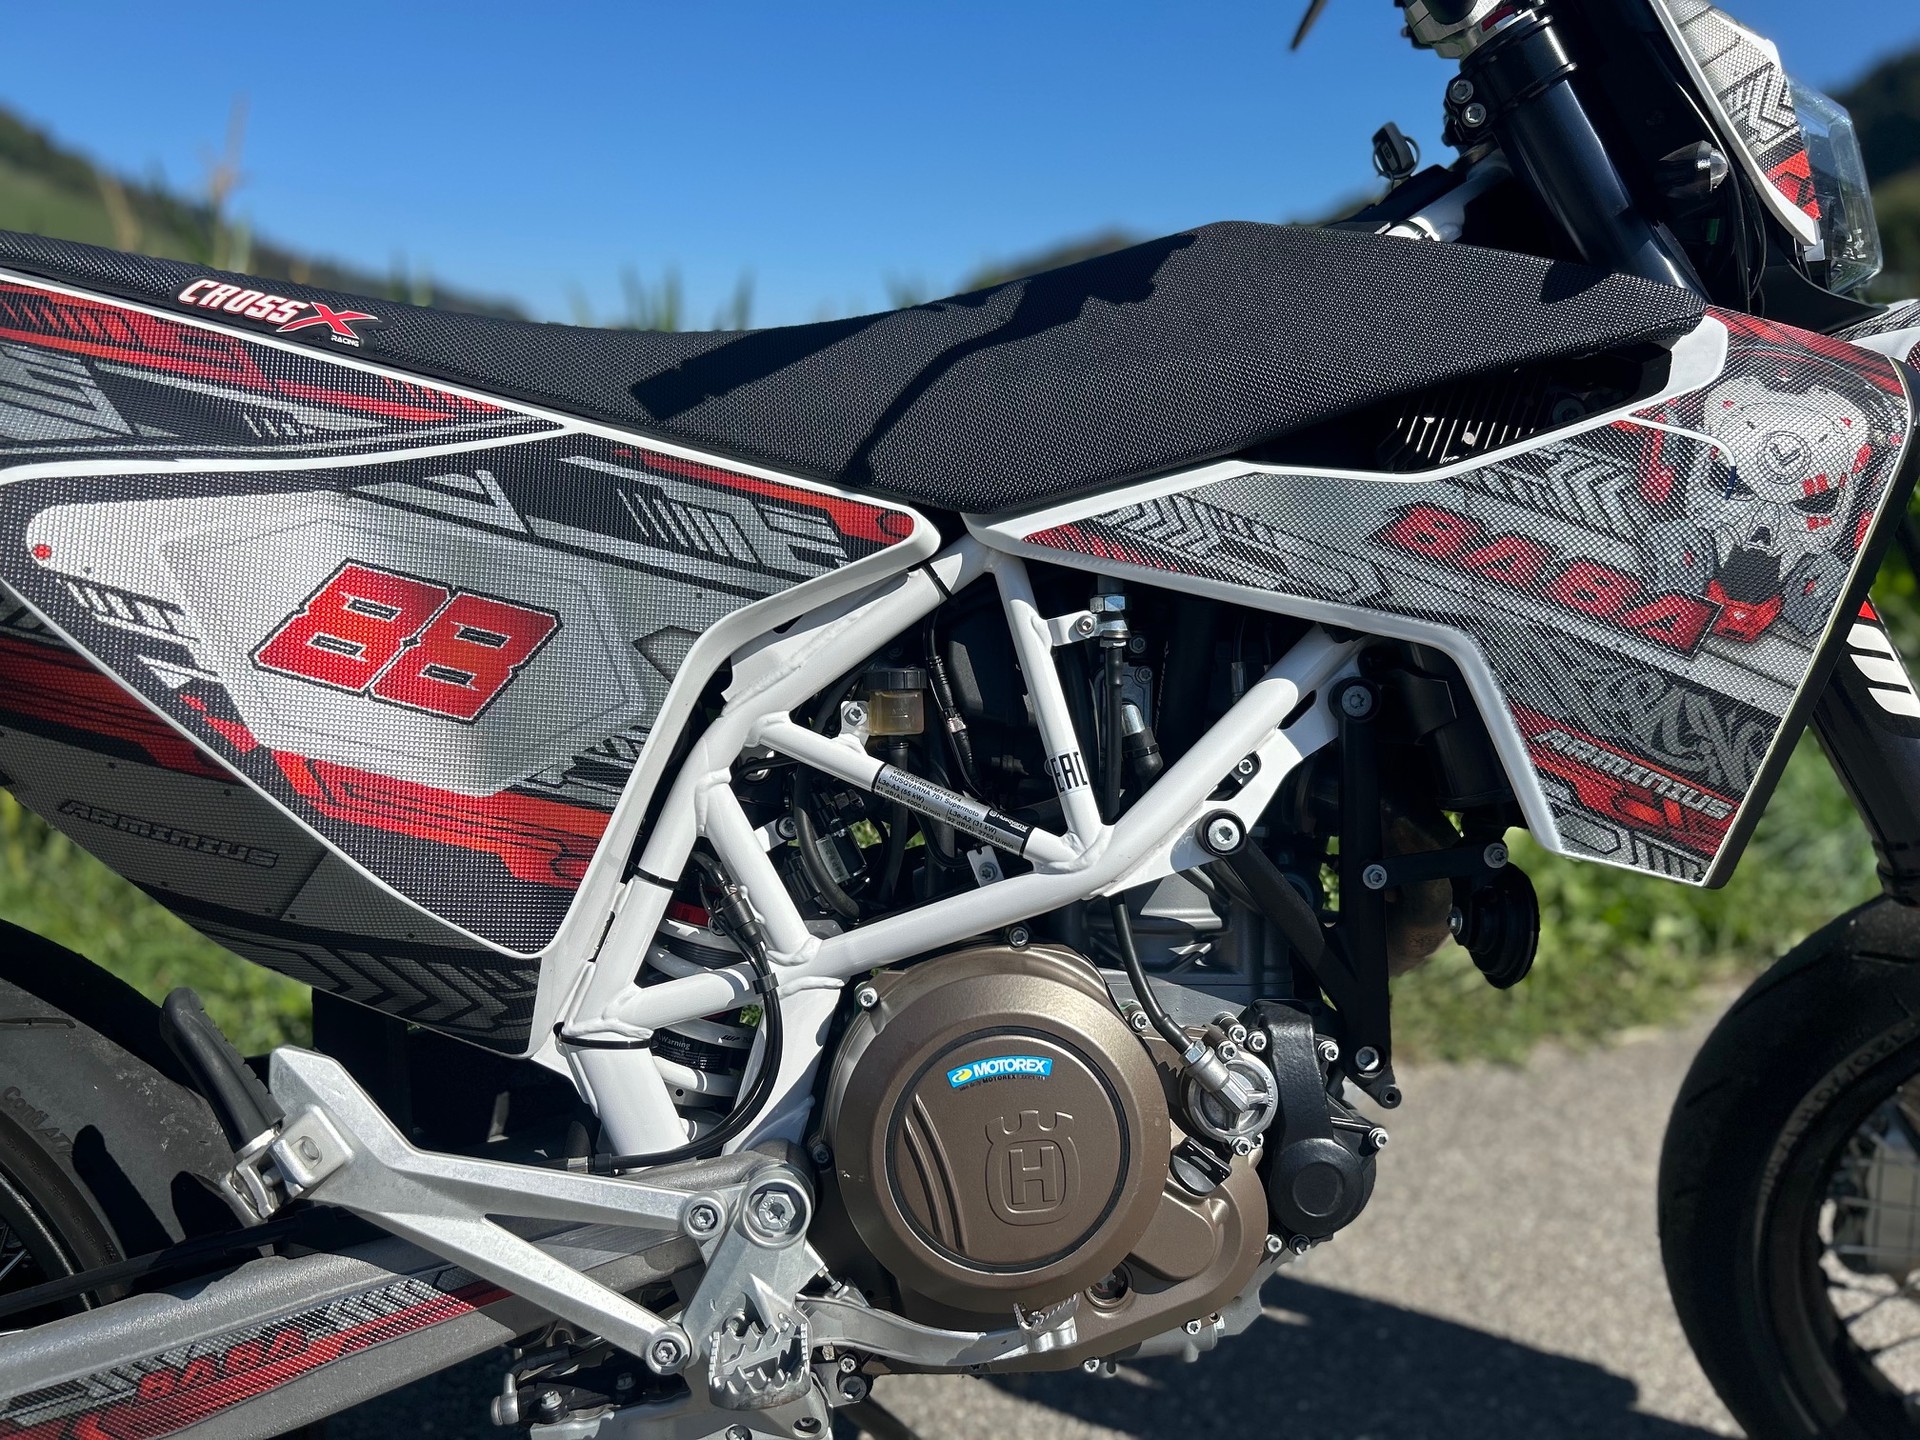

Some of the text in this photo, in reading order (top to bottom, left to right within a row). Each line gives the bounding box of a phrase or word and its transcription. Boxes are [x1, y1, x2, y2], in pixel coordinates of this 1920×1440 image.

[331, 334, 360, 348] RACING
[1374, 501, 1720, 653] BABA
[250, 558, 562, 724] 88
[889, 774, 980, 818] HUSQVARNA 701 Supermoto
[1531, 728, 1734, 821] ARMINIUS
[912, 792, 925, 804] kW)
[58, 798, 280, 869] ARMINIUS
[984, 823, 997, 835] kW)
[972, 1059, 1046, 1077] MOTOREX
[982, 1074, 1017, 1084] MOTOREX
[135, 1326, 309, 1402] BABA
